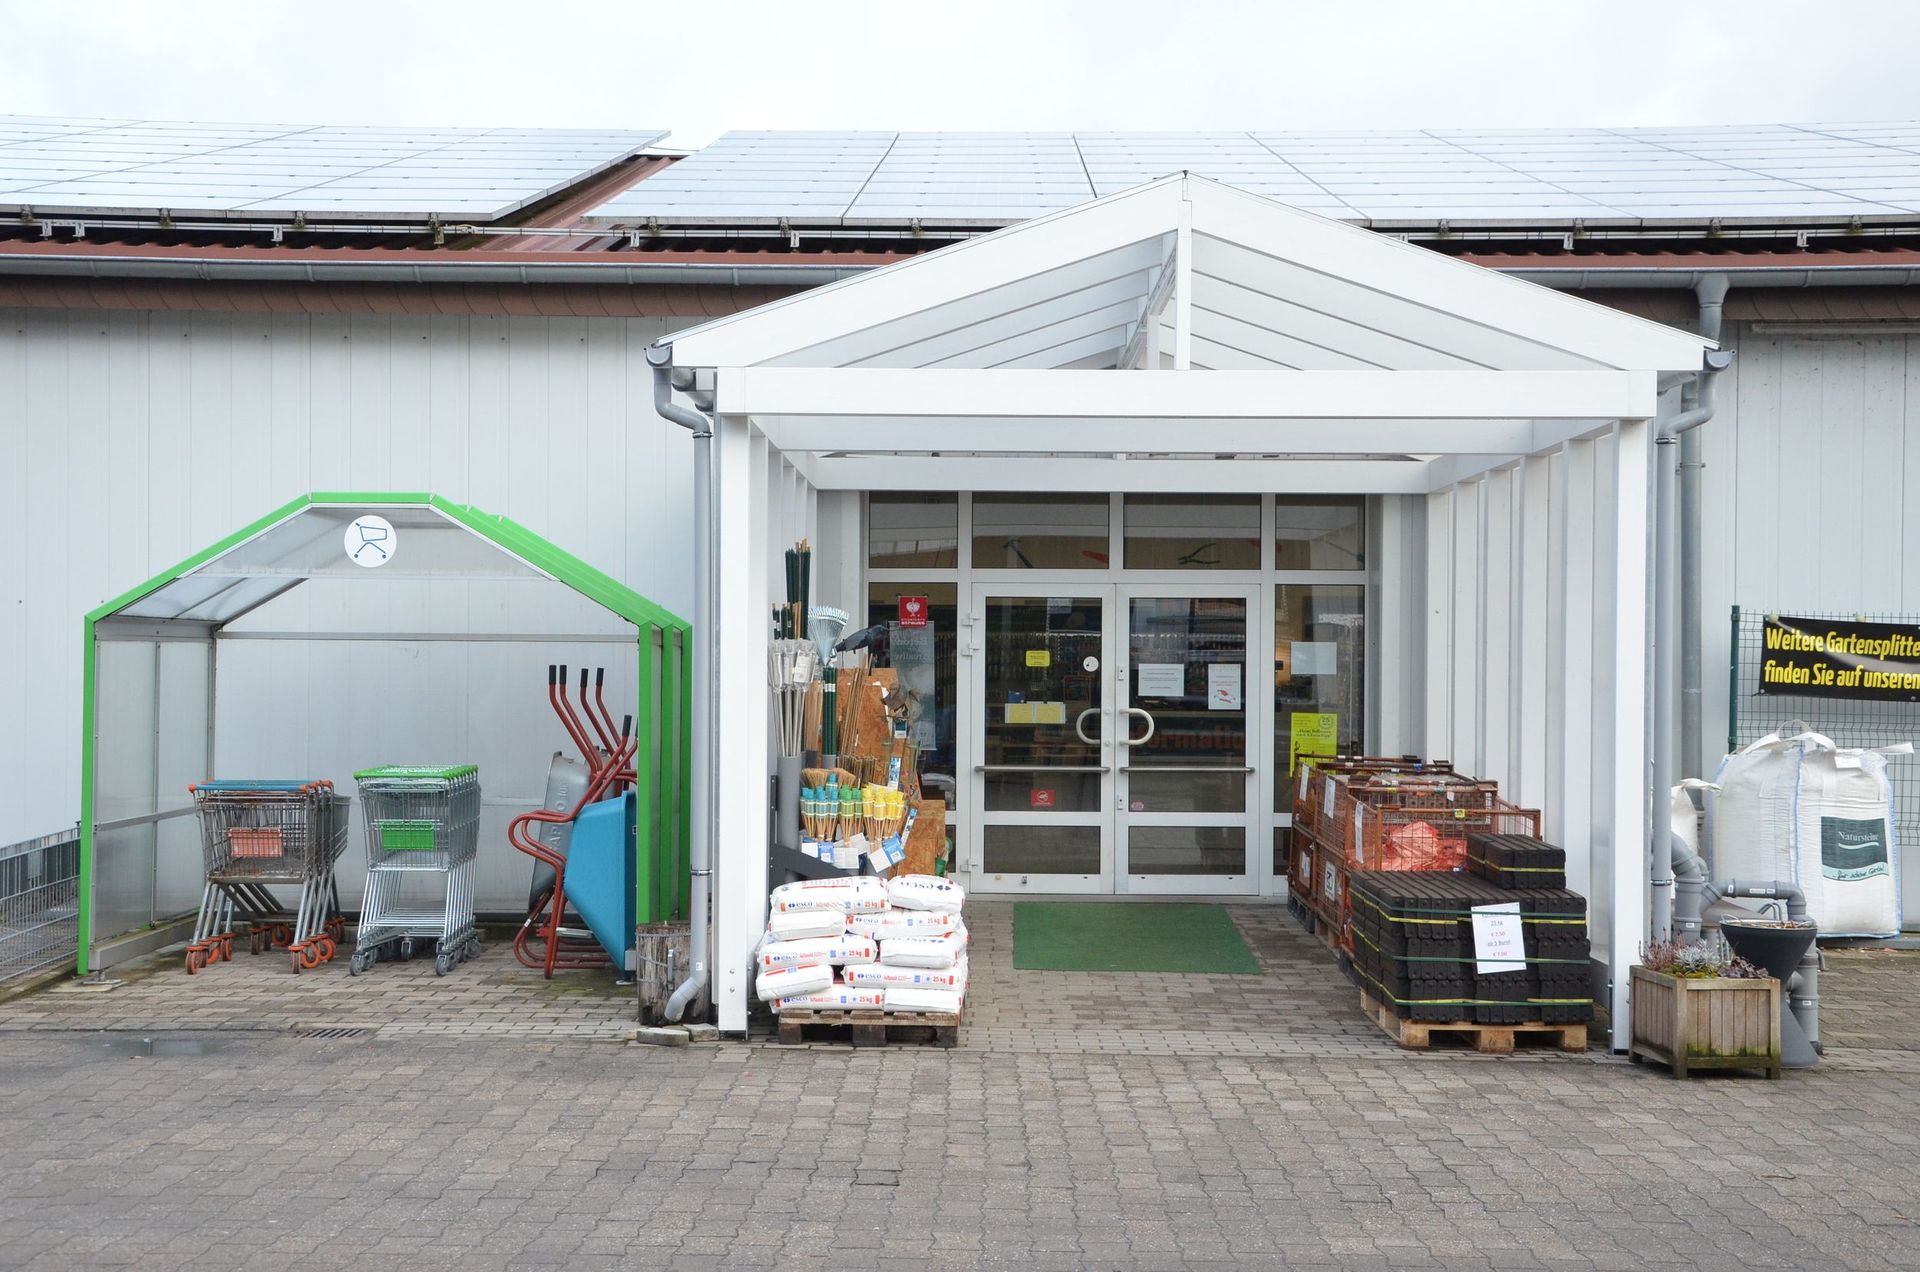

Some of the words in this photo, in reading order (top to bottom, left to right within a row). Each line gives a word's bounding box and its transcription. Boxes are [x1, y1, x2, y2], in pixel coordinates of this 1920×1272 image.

[1766, 627, 1824, 653] Weitere
[1826, 631, 1920, 661] Gartensplitte
[1764, 660, 1810, 685] finden
[1812, 663, 1836, 686] Sie
[1837, 664, 1864, 687] auf
